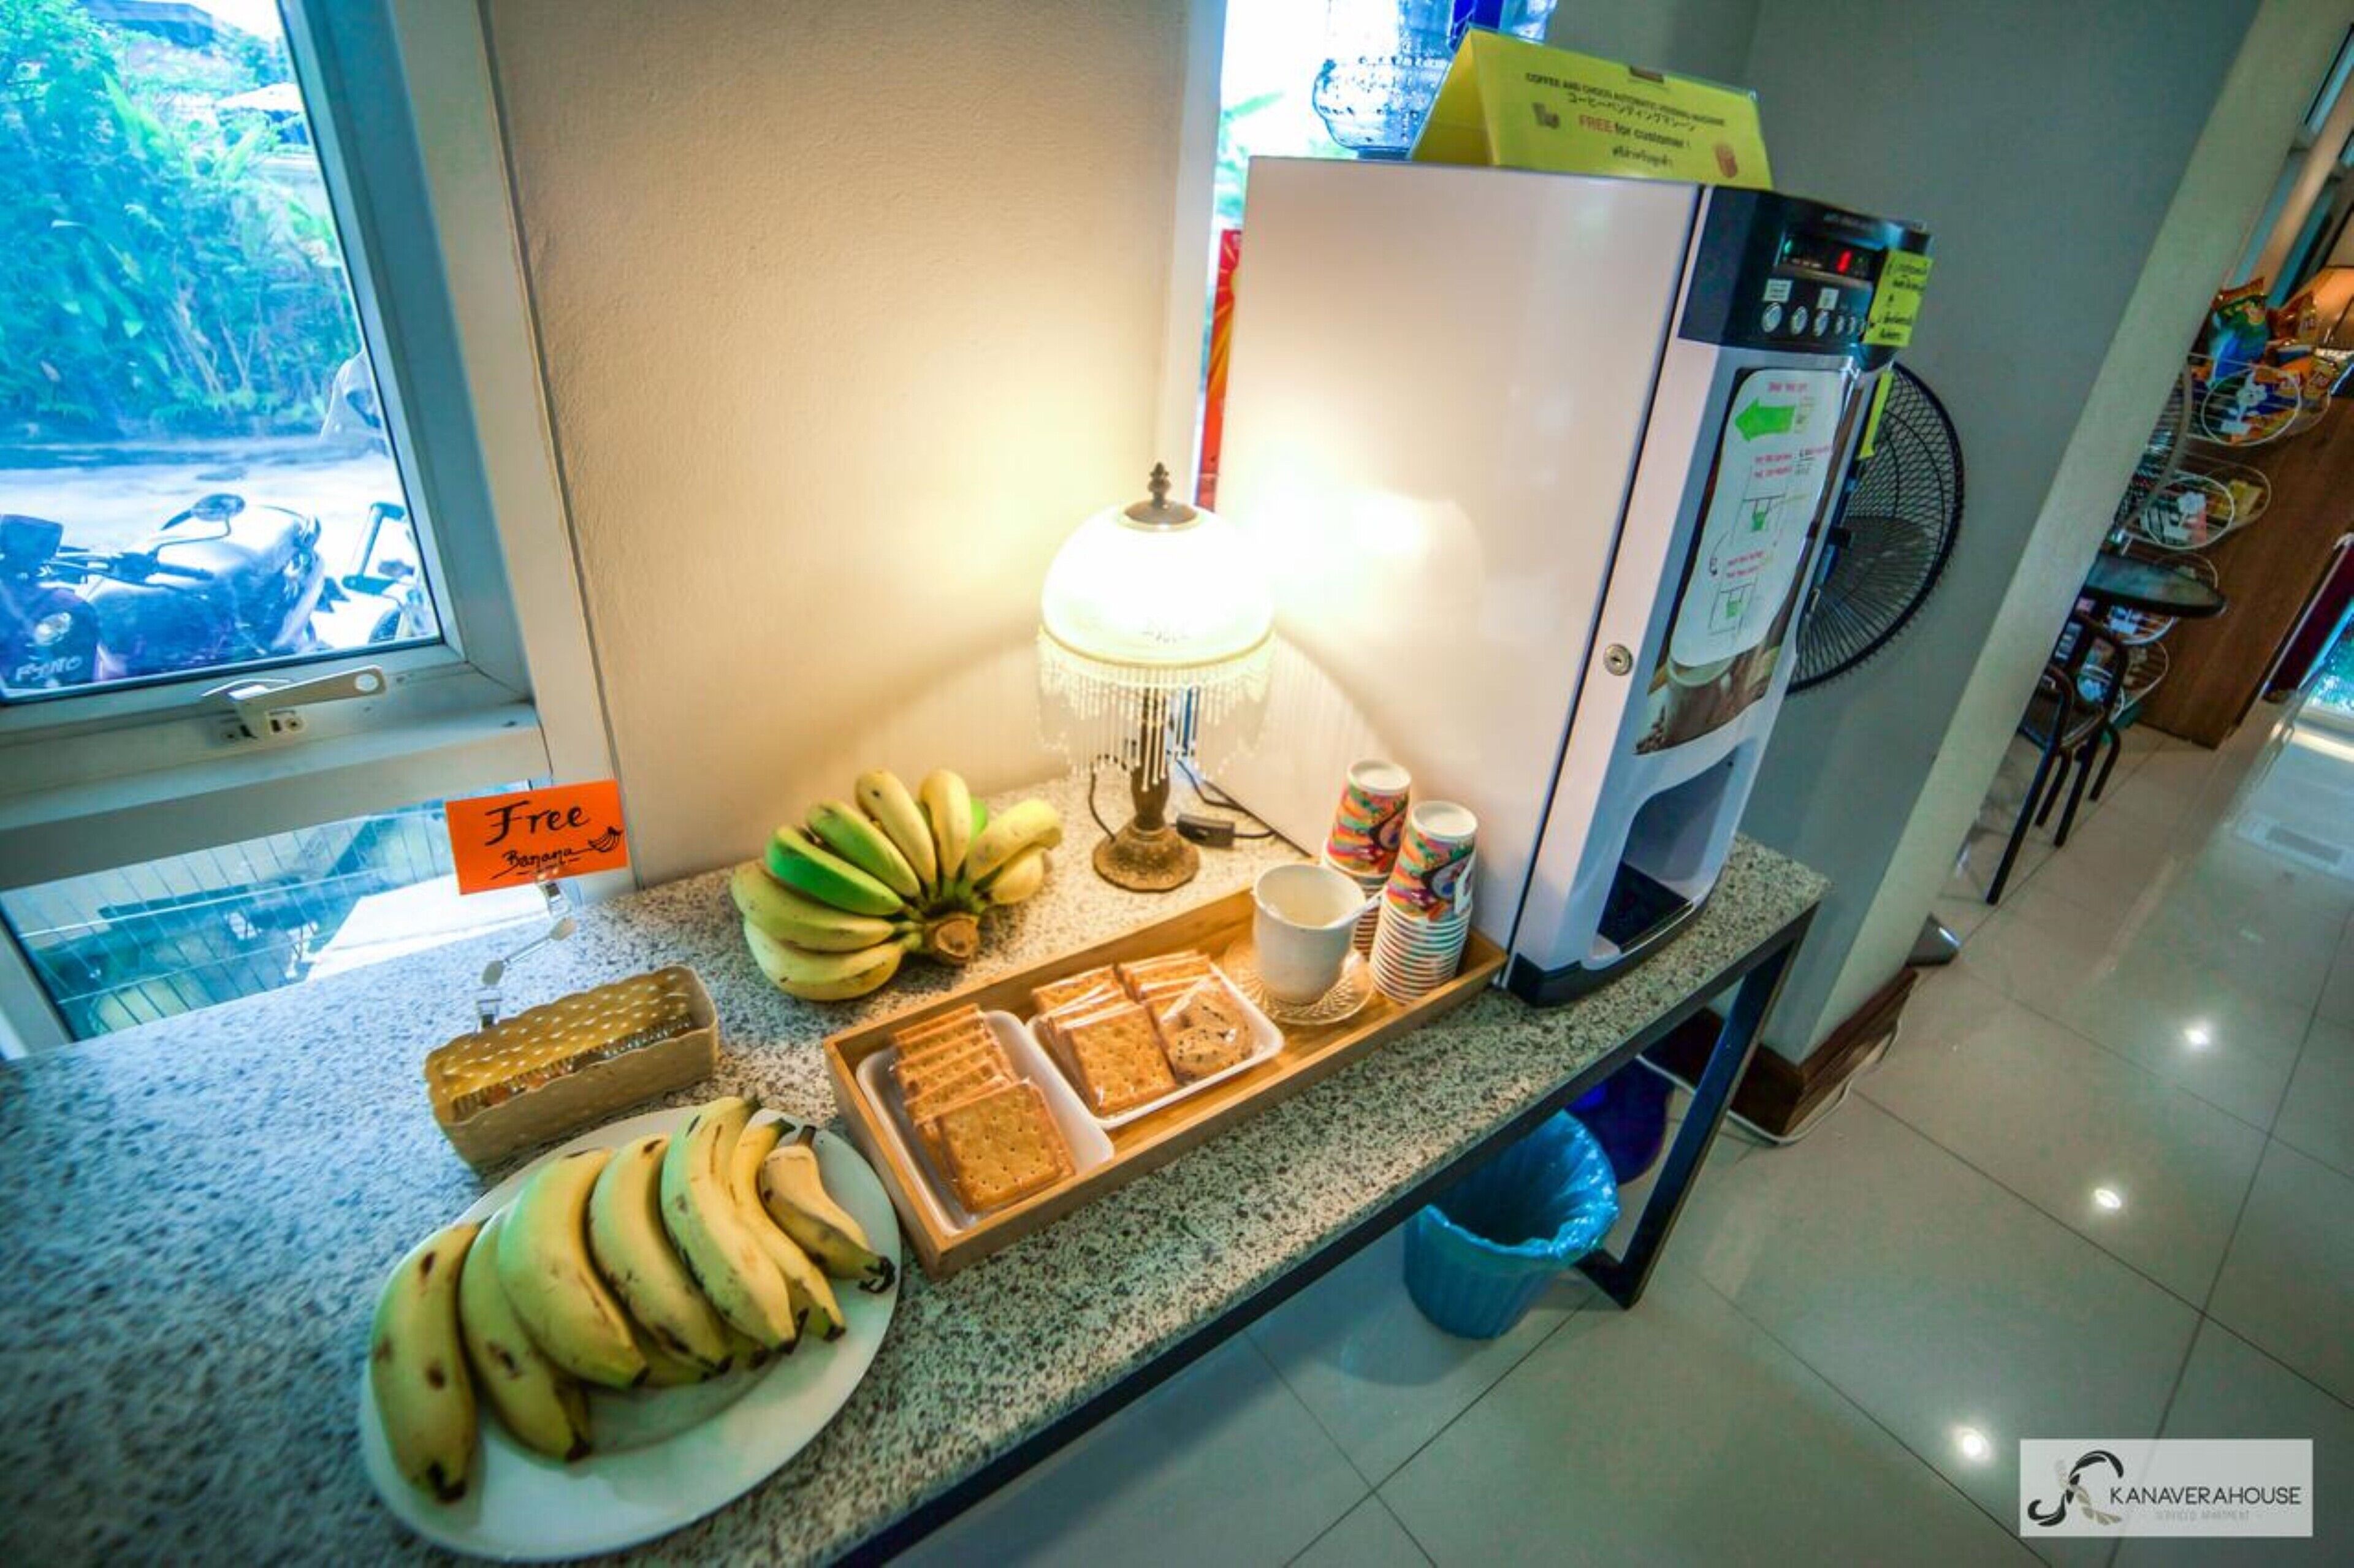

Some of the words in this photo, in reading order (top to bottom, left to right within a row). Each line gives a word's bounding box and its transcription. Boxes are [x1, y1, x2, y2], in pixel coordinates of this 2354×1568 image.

[1525, 72, 1560, 88] COFFEE
[1579, 114, 1614, 133] FREE
[1614, 122, 1631, 136] for
[1633, 129, 1685, 148] customer
[484, 800, 590, 846] Free
[501, 847, 576, 869] Banana
